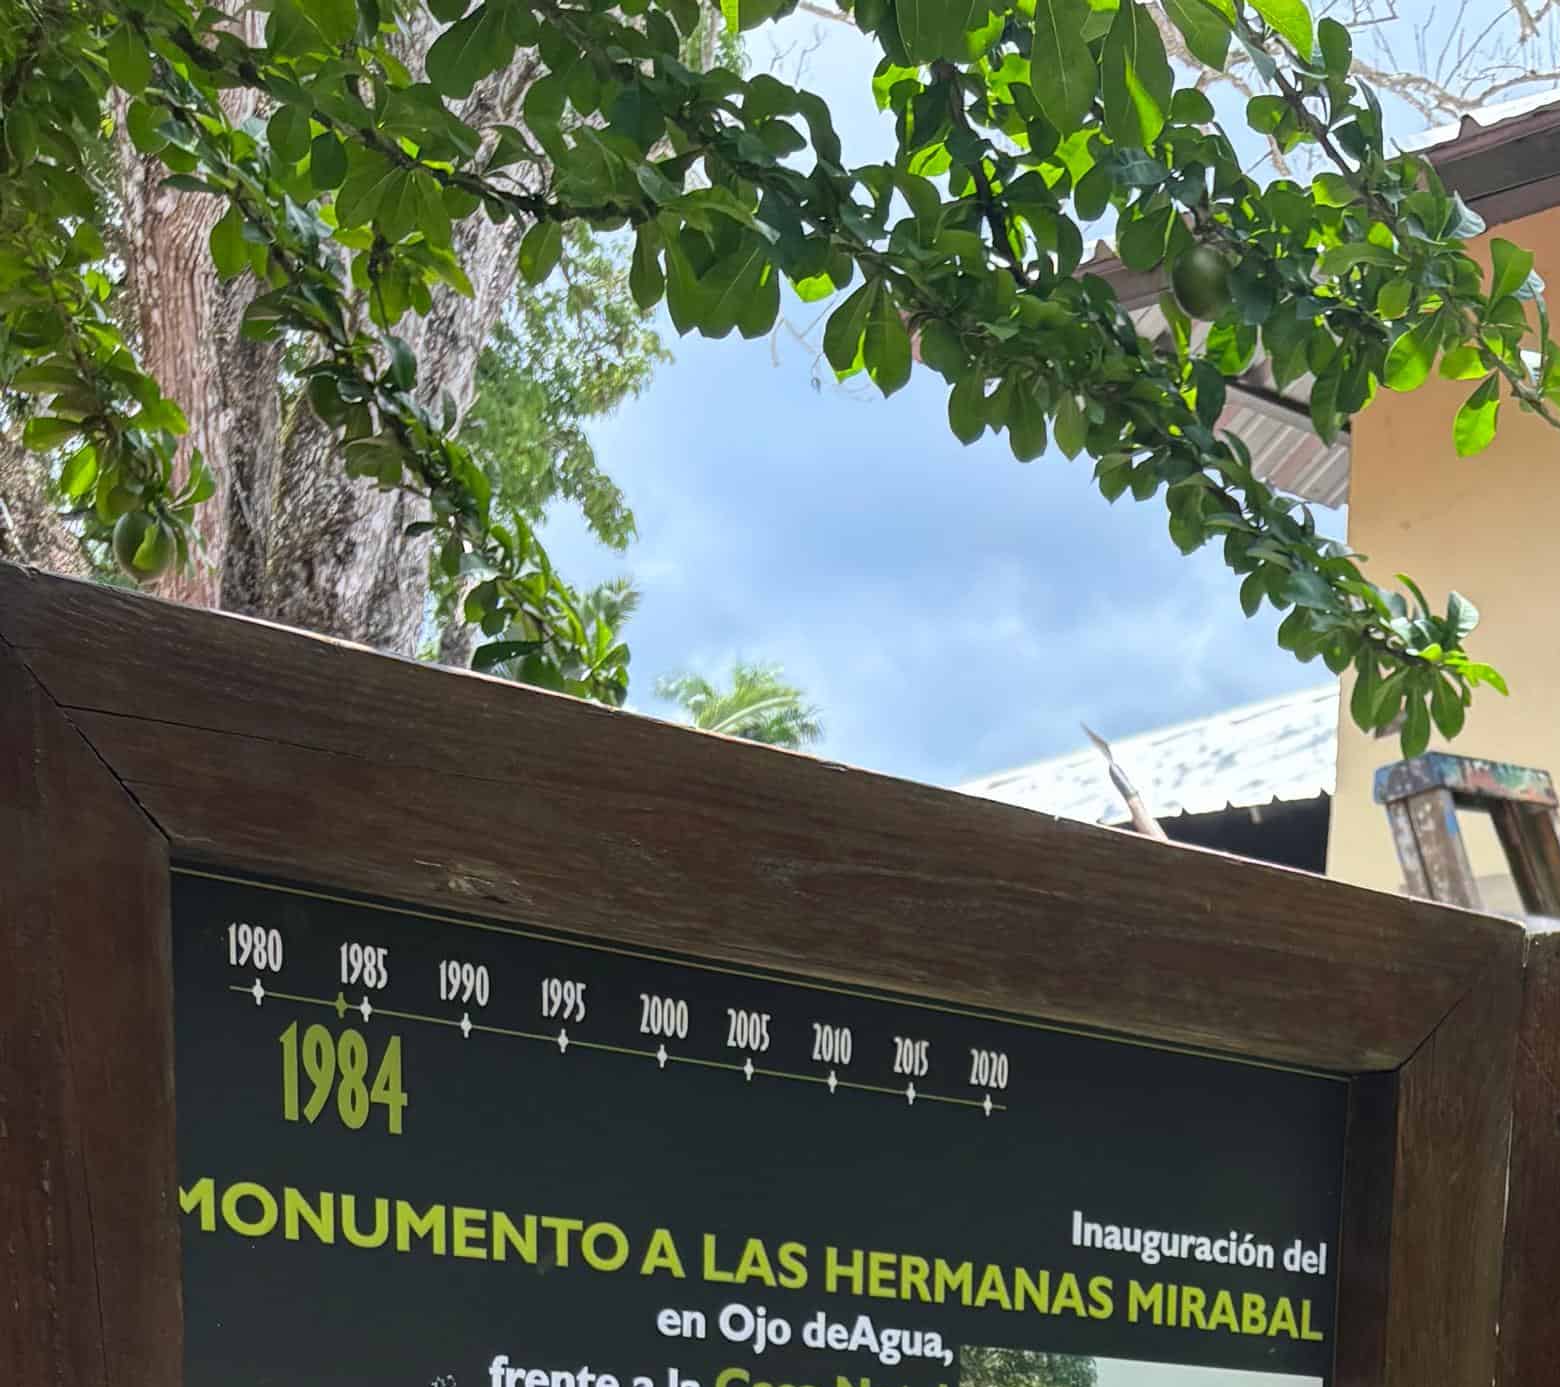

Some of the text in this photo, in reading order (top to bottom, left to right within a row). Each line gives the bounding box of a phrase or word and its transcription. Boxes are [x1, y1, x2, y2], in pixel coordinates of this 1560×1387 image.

[228, 923, 1009, 1089] 1980 1985 1990 1995 2000 2005 2010 2015 2020
[279, 1021, 408, 1135] 1984
[178, 1177, 1323, 1341] MONUMENTO A LAS HERMANAS MIRABAL
[1072, 1210, 1327, 1275] Inauguración del
[657, 1308, 706, 1339] en
[718, 1303, 792, 1354] Ojo
